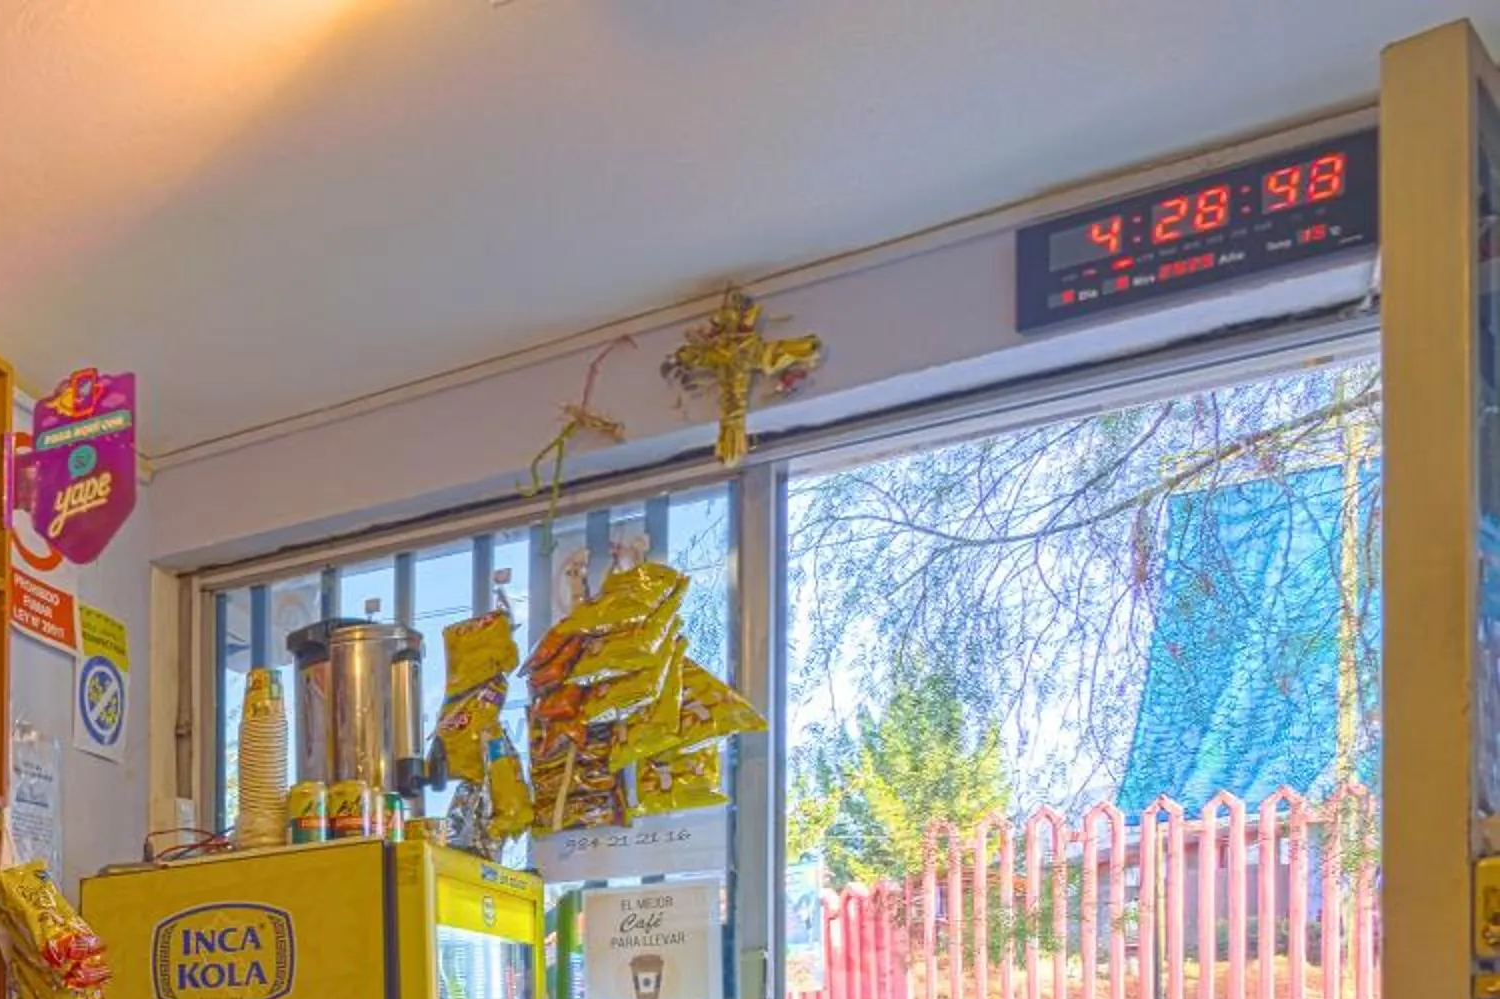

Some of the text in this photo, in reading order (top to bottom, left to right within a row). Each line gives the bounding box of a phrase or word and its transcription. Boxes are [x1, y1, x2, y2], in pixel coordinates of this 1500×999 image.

[49, 471, 112, 540] yape
[636, 895, 674, 909] MEJOR
[619, 911, 664, 934] Café
[182, 926, 262, 956] INCA
[610, 931, 685, 948] PARA LLEVAR
[177, 960, 267, 991] KOLA
